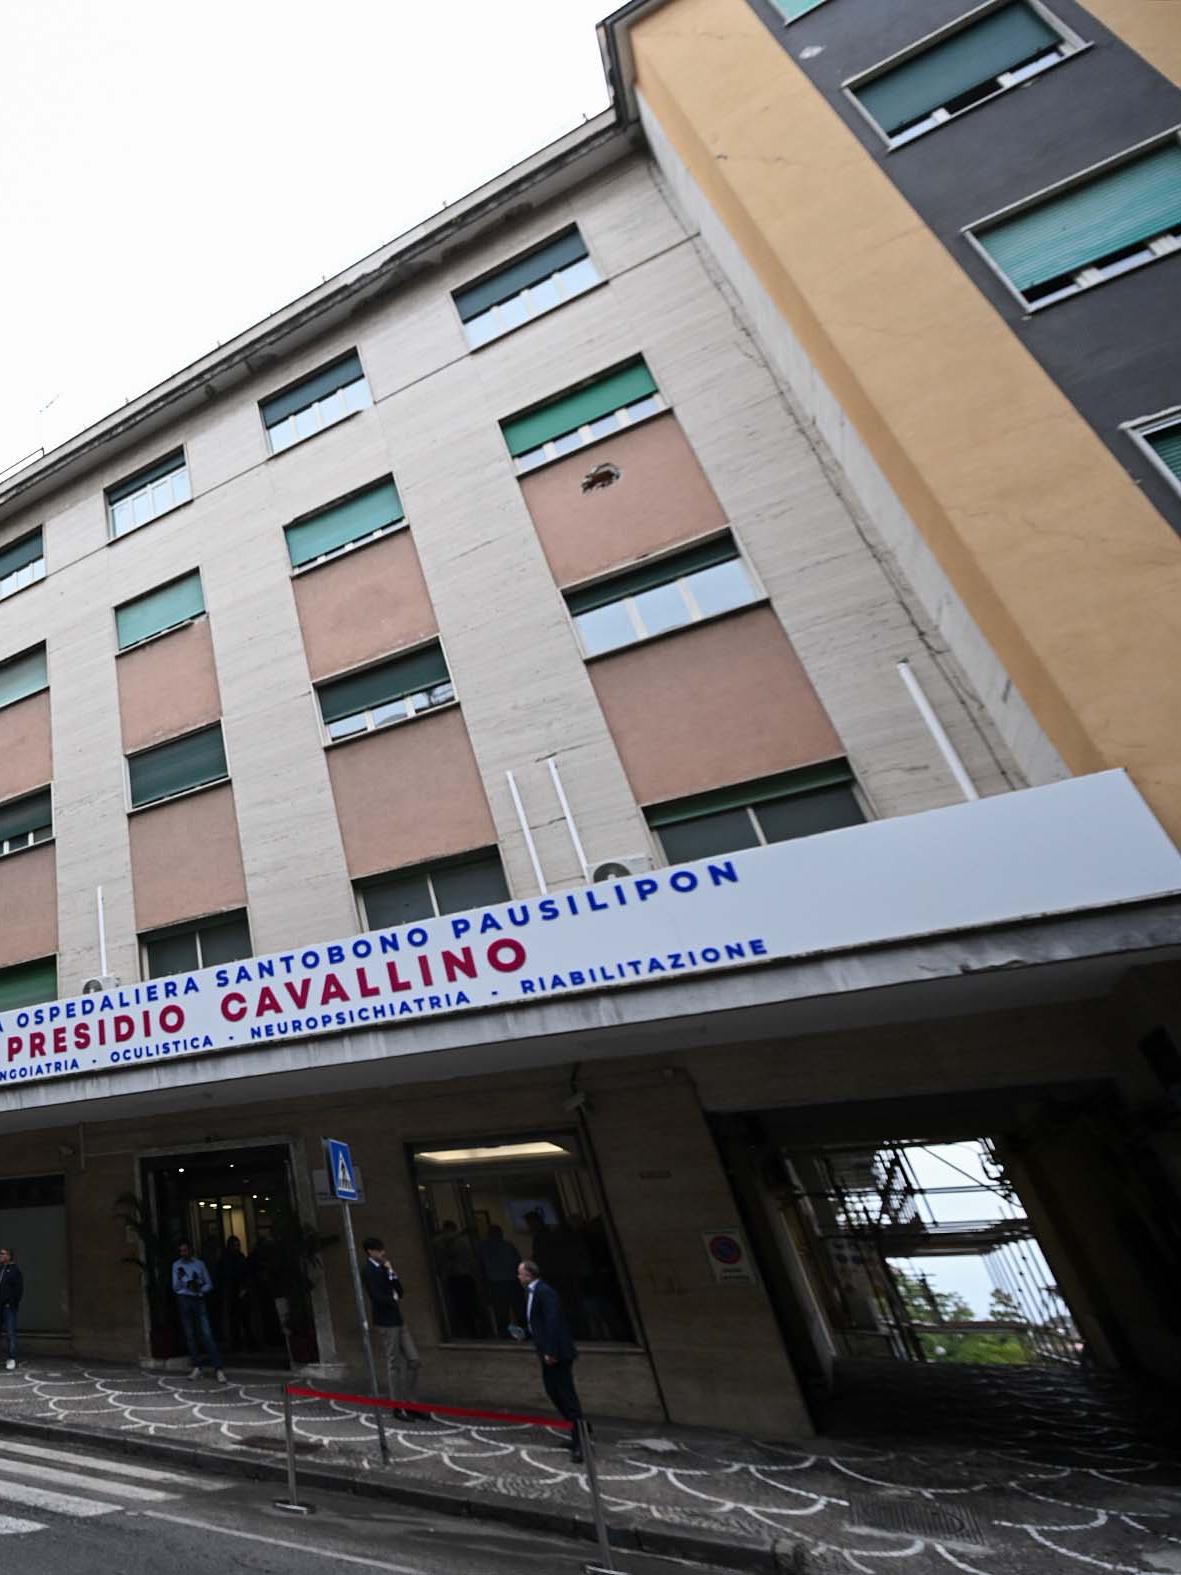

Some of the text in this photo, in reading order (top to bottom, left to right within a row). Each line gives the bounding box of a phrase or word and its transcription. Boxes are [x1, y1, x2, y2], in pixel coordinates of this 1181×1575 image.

[7, 938, 527, 1062] PRESIDIO CAVALLINO
[16, 976, 200, 1029] OSPEDALIERA
[215, 927, 429, 988] SANTOBONO
[450, 860, 740, 940] PAUSILIPON
[110, 1035, 214, 1064] OCULISTICA
[250, 990, 472, 1040] NEUROPSICHIATRIA
[519, 938, 768, 994] RIABILITAZIONE
